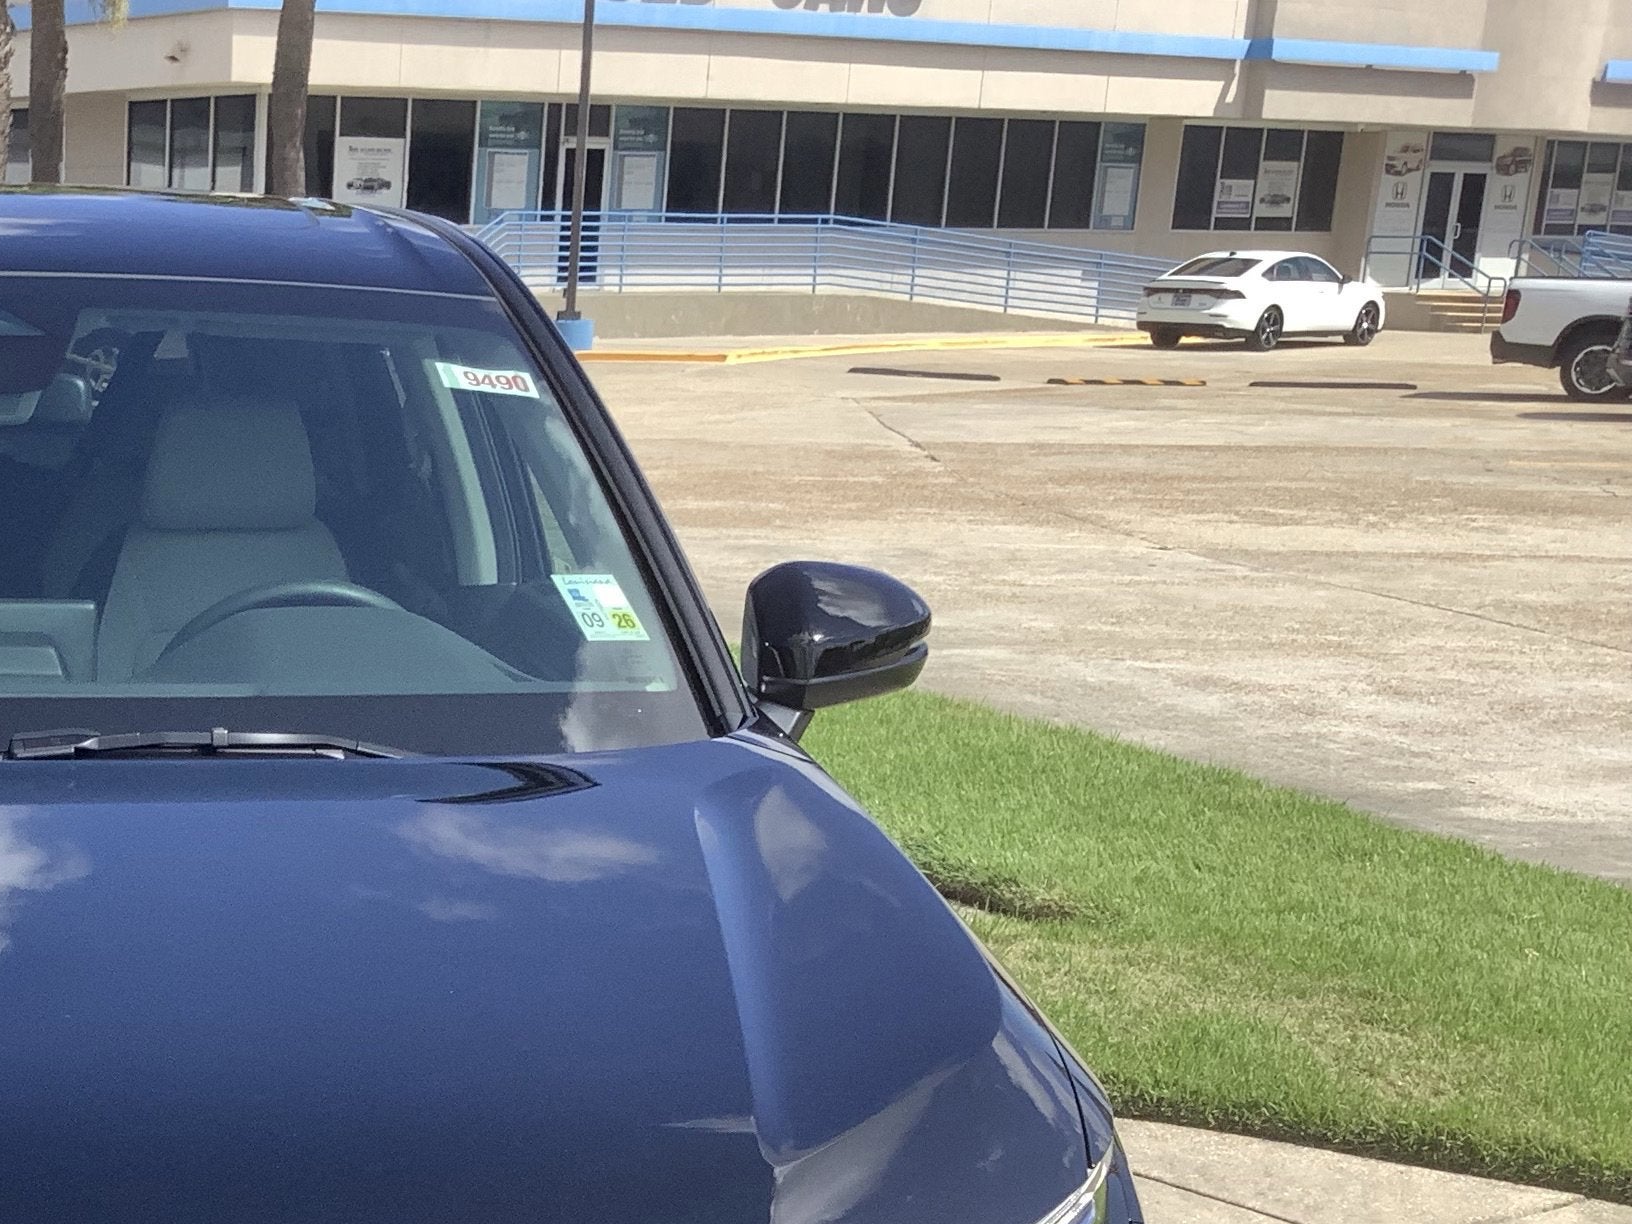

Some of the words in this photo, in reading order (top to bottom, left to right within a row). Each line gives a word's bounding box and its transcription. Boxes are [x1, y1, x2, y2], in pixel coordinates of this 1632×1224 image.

[463, 371, 530, 392] 9490
[581, 612, 605, 628] 09
[612, 612, 636, 629] 26
